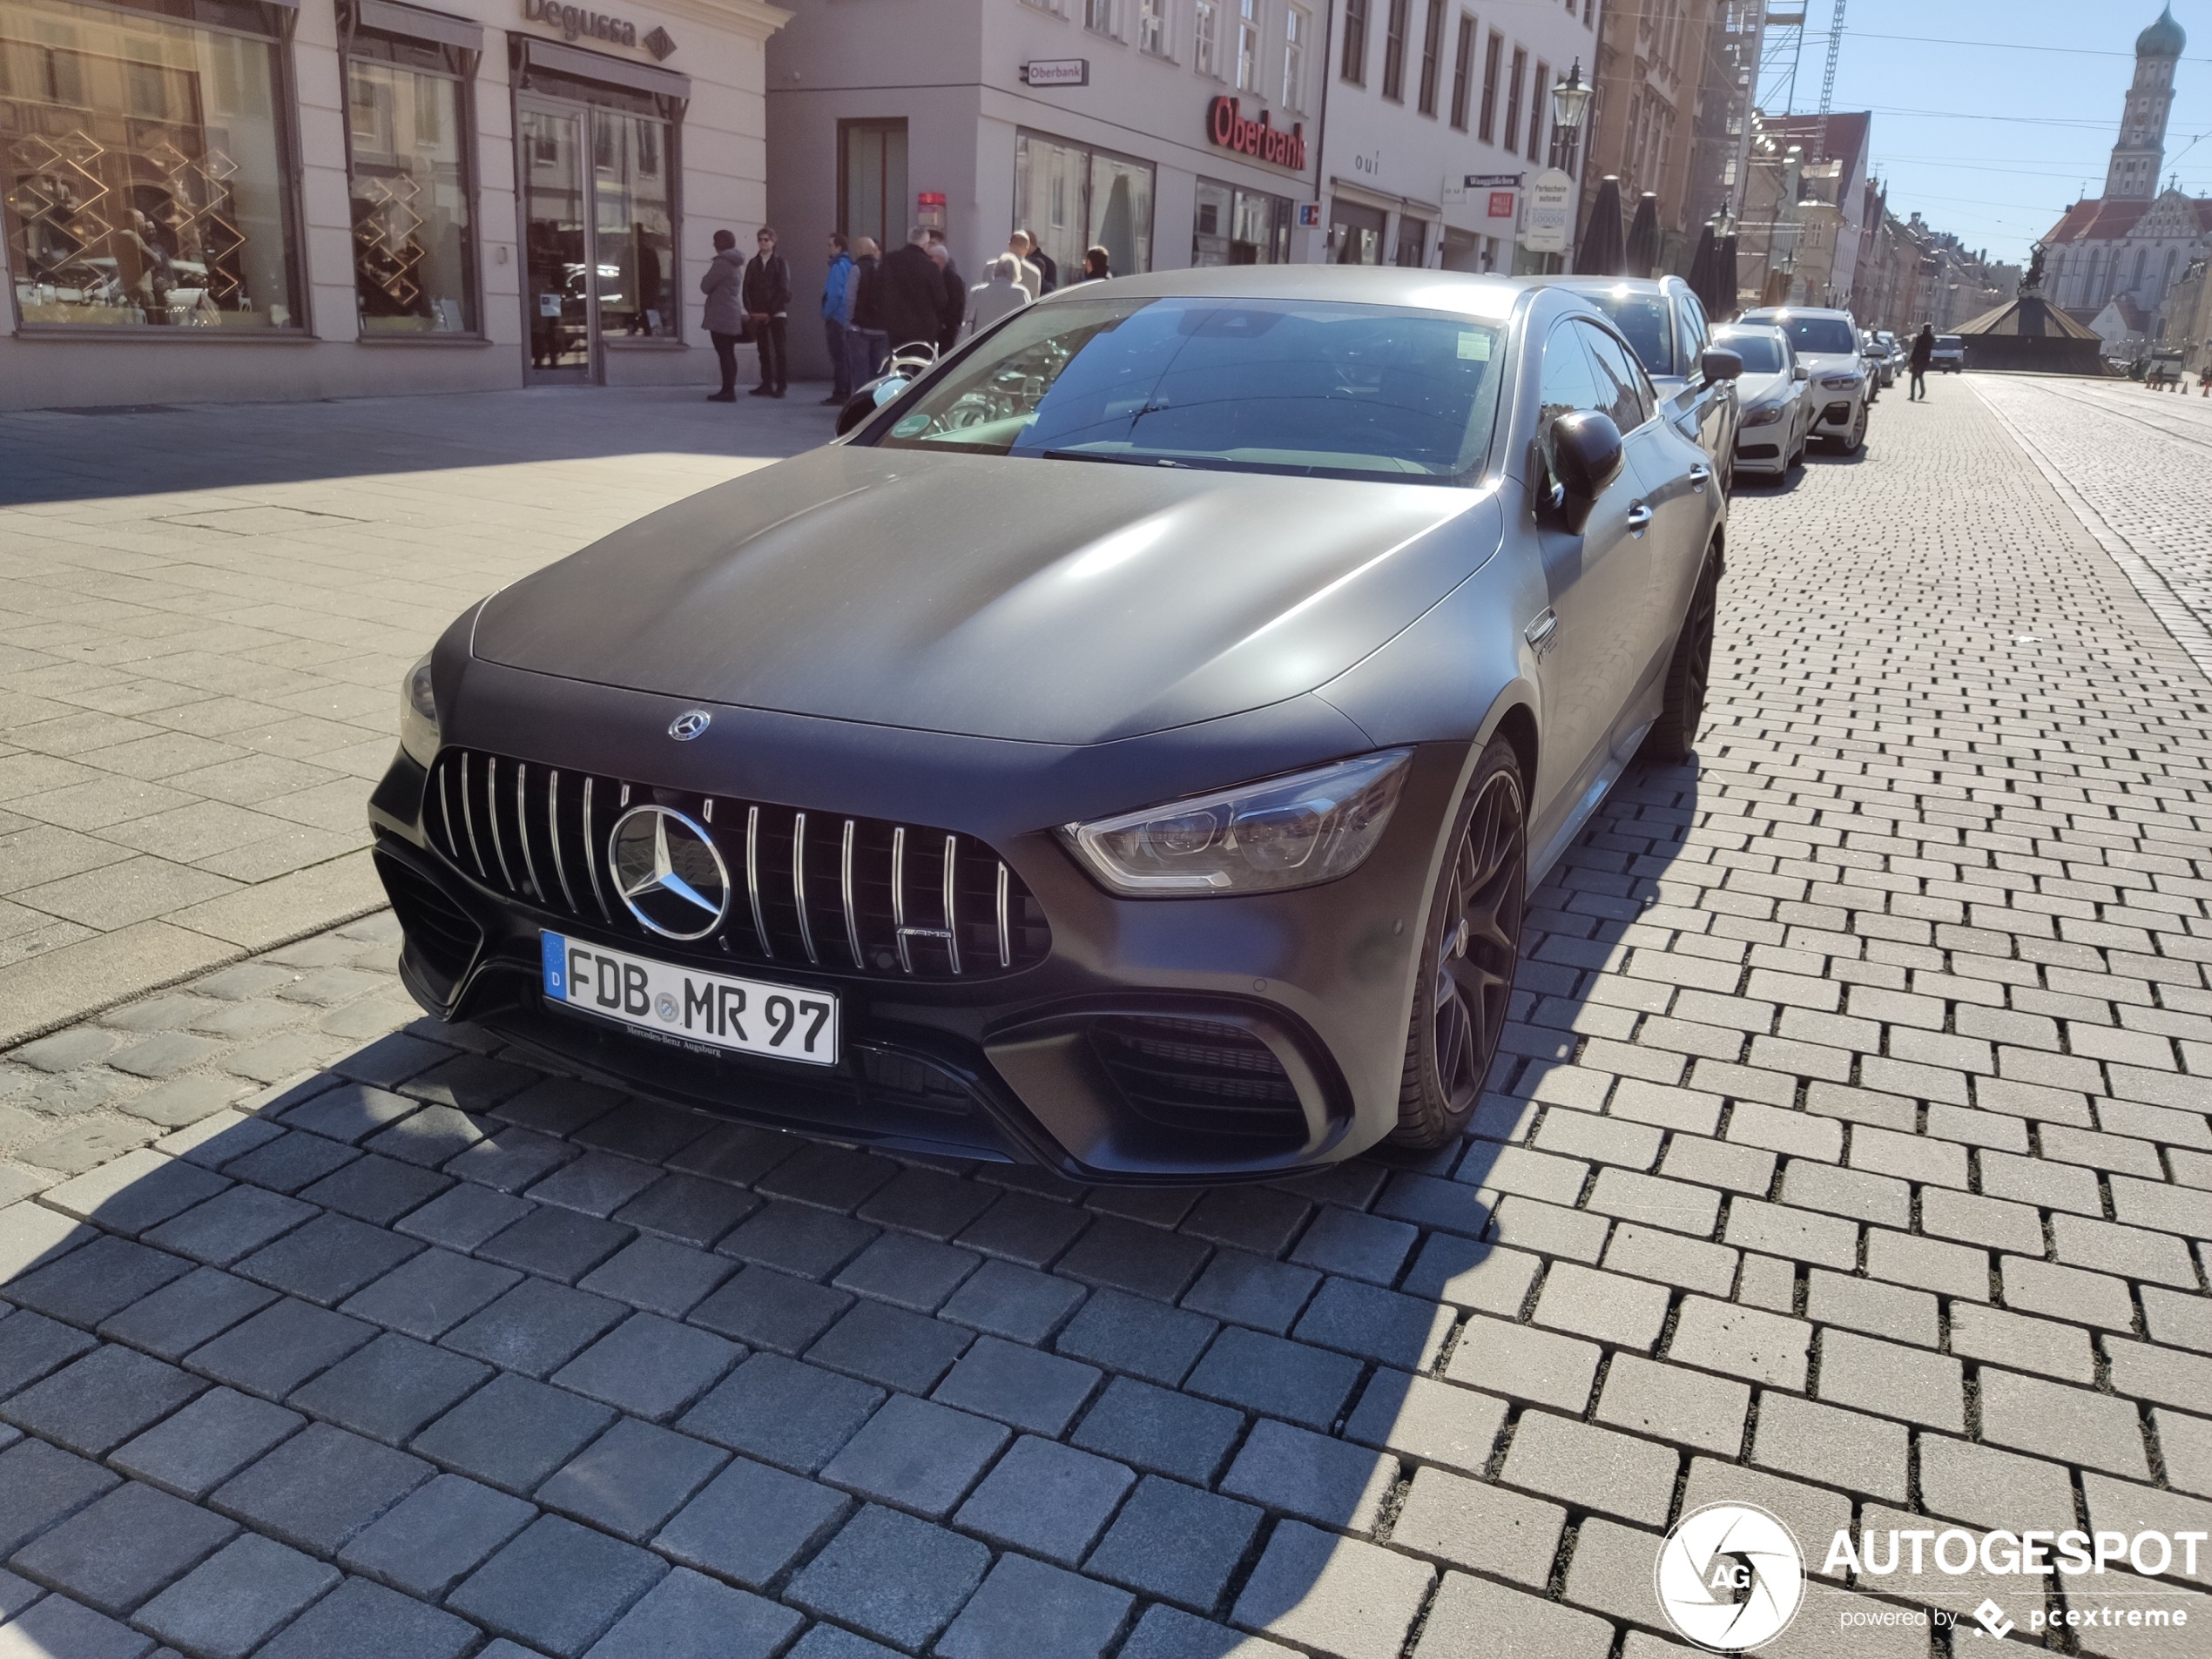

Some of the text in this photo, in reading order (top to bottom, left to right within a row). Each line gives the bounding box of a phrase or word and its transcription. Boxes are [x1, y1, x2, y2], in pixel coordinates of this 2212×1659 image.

[525, 0, 637, 46] Degussa
[1030, 65, 1080, 78] Oberbank
[1209, 96, 1306, 171] Oberbank
[1354, 150, 1379, 175] oui
[914, 929, 952, 939] AMG
[551, 971, 561, 987] D
[569, 948, 830, 1053] FDB MR 97
[627, 1026, 722, 1058] Mercedes-Benz Augsburg
